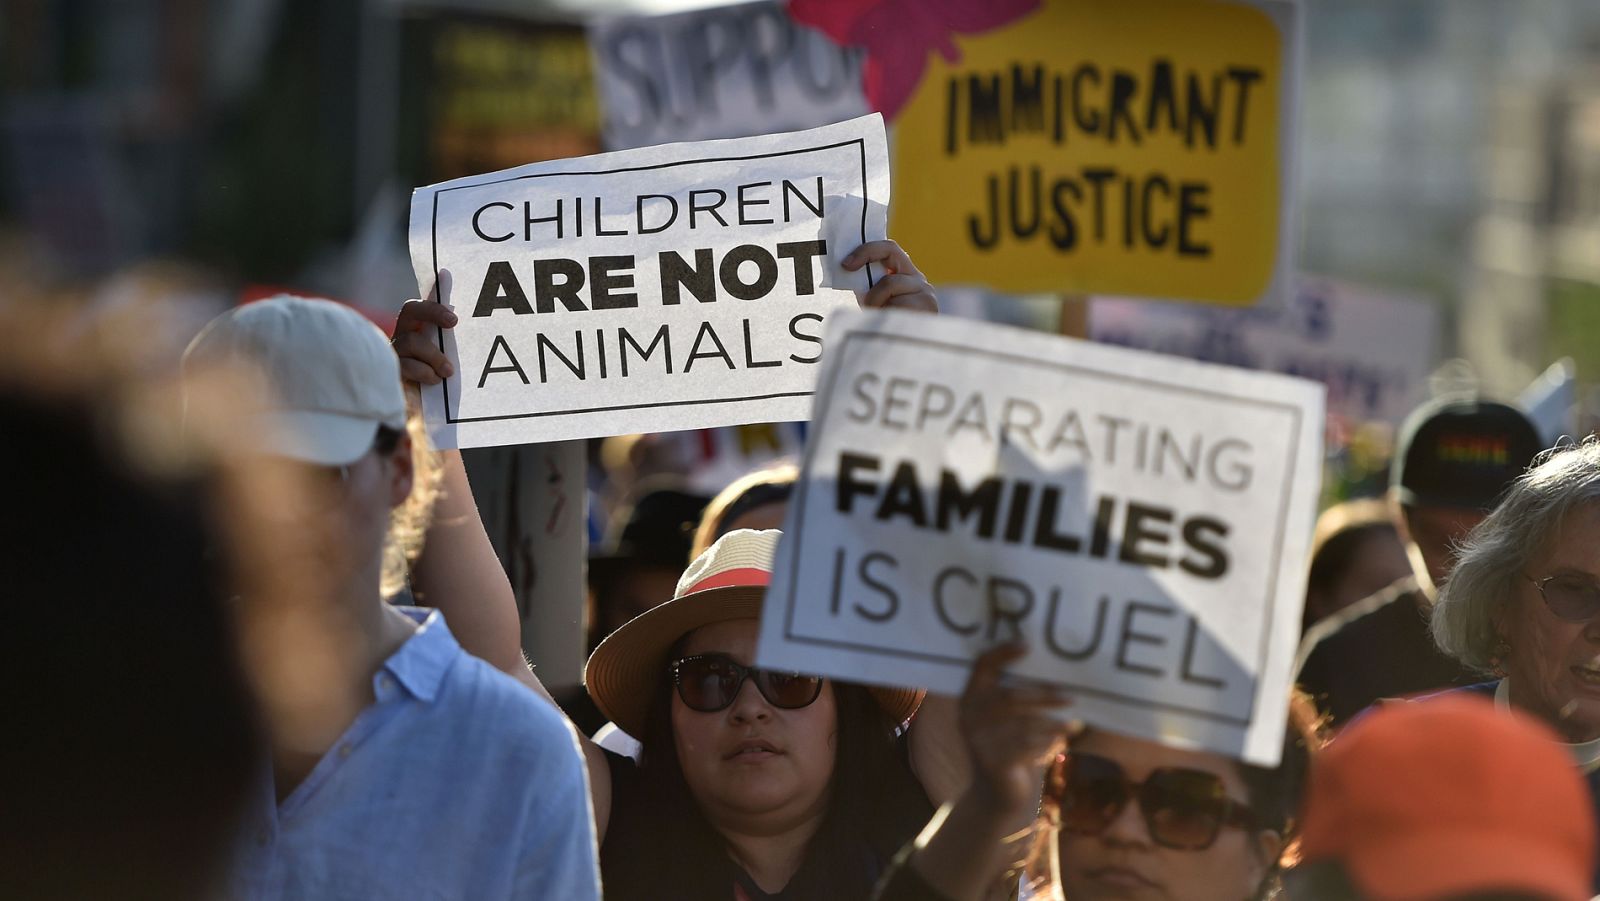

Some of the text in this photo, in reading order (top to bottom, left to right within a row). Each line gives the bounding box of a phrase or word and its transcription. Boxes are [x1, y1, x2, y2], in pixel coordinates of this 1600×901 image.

[945, 58, 1264, 156] IMMIGRANT
[472, 177, 825, 243] CHILDREN
[967, 166, 1213, 258] JUSTICE
[472, 240, 828, 318] ARE NOT
[477, 313, 824, 389] ANIMALS
[847, 372, 1255, 493] SEPARATING
[834, 452, 1230, 580] FAMILIES
[830, 548, 1228, 690] IS CRUEL
